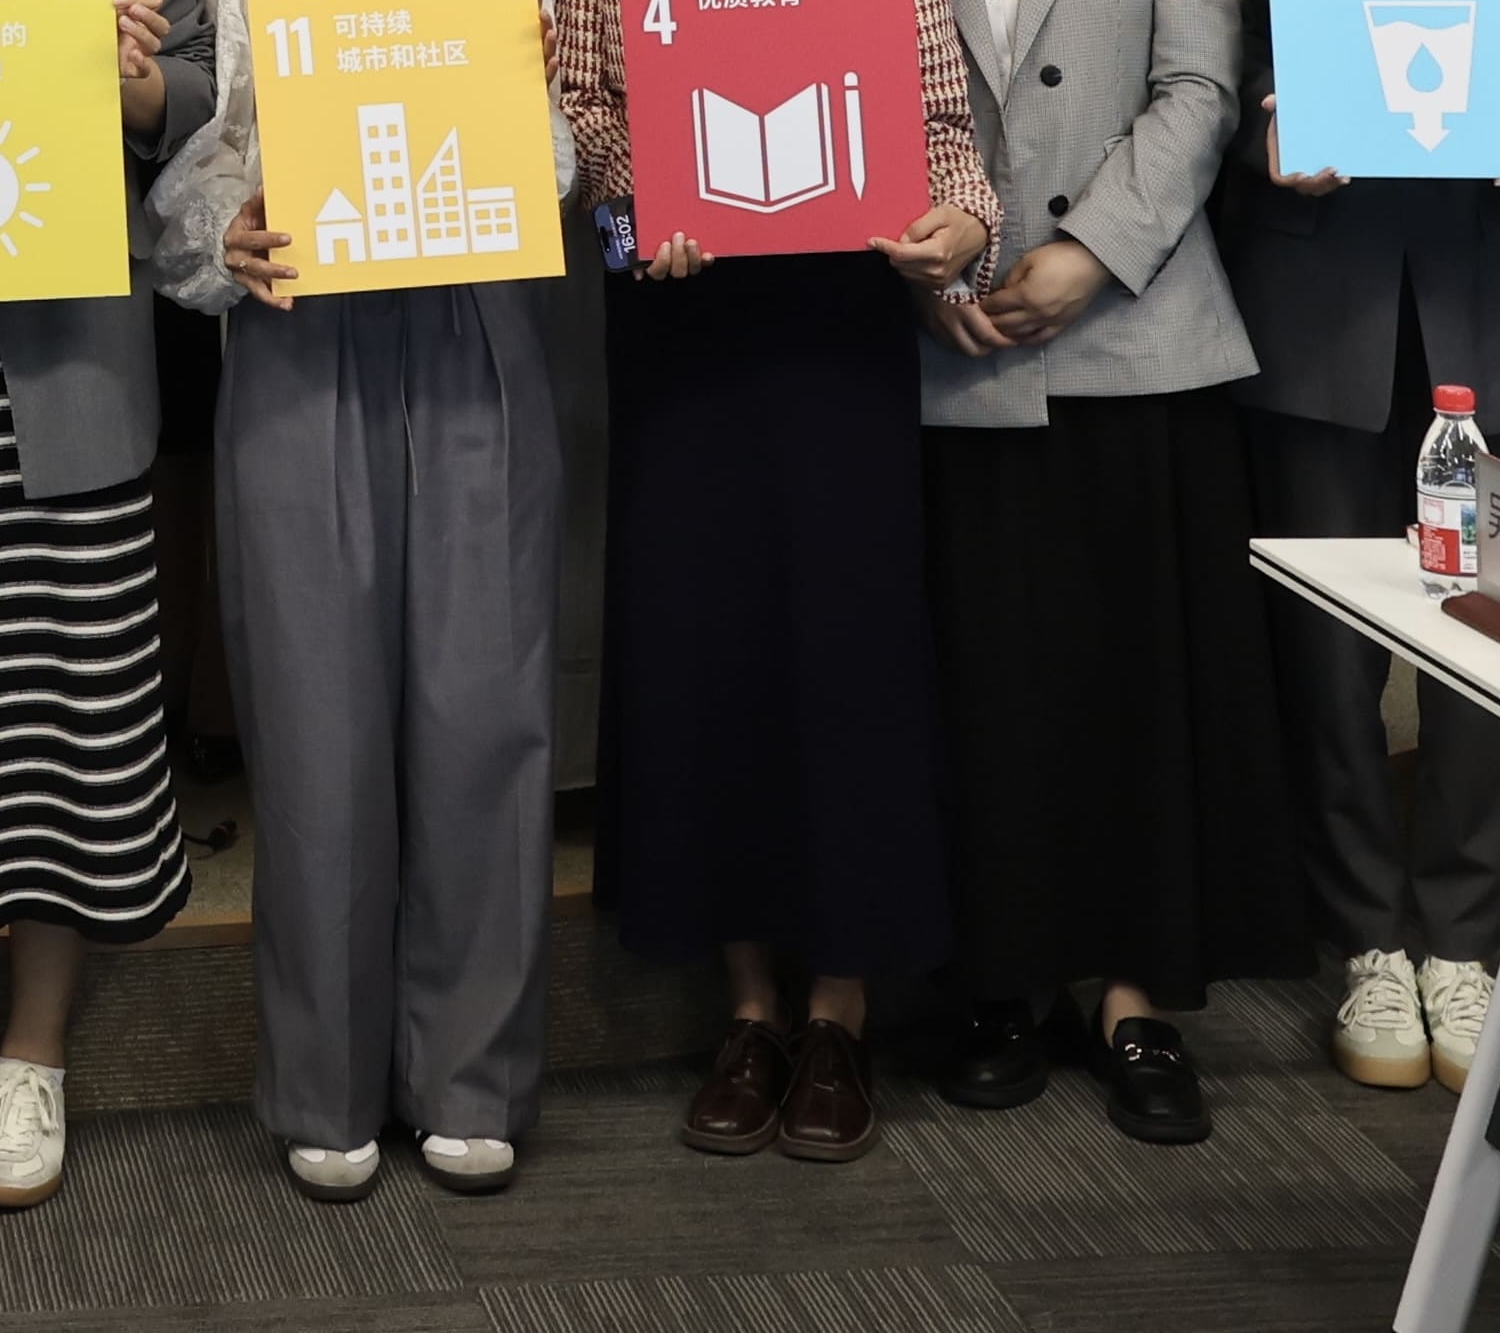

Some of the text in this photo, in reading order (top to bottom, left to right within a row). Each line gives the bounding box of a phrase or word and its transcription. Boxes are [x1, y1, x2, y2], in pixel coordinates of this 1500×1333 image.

[334, 10, 411, 38] 可持续
[267, 17, 313, 76] 11
[337, 40, 468, 72] 城市和社区
[616, 214, 636, 254] 16:02
